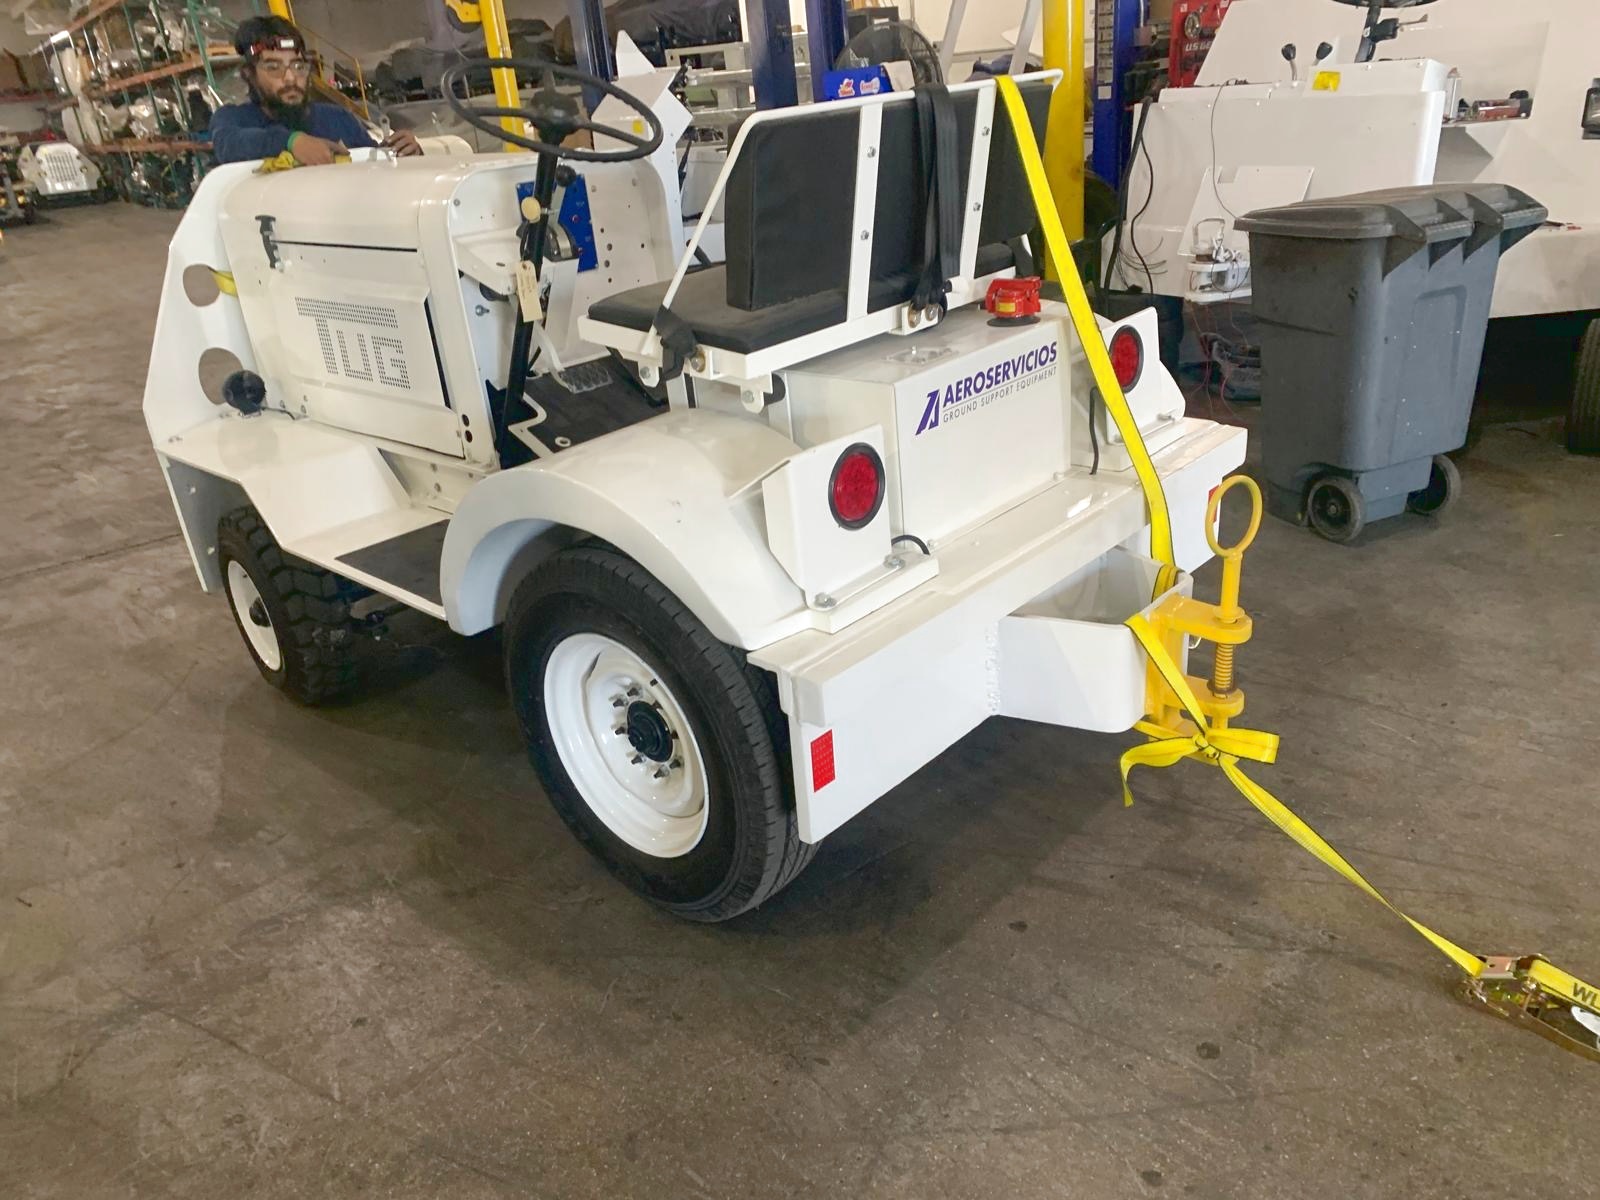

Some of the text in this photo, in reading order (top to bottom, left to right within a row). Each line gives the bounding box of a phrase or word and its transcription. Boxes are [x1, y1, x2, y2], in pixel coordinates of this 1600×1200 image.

[294, 297, 411, 390] TUG
[942, 341, 1058, 408] AEROSERVICIOS
[943, 366, 1057, 423] GROUND SUPPORT EQUIPMENT
